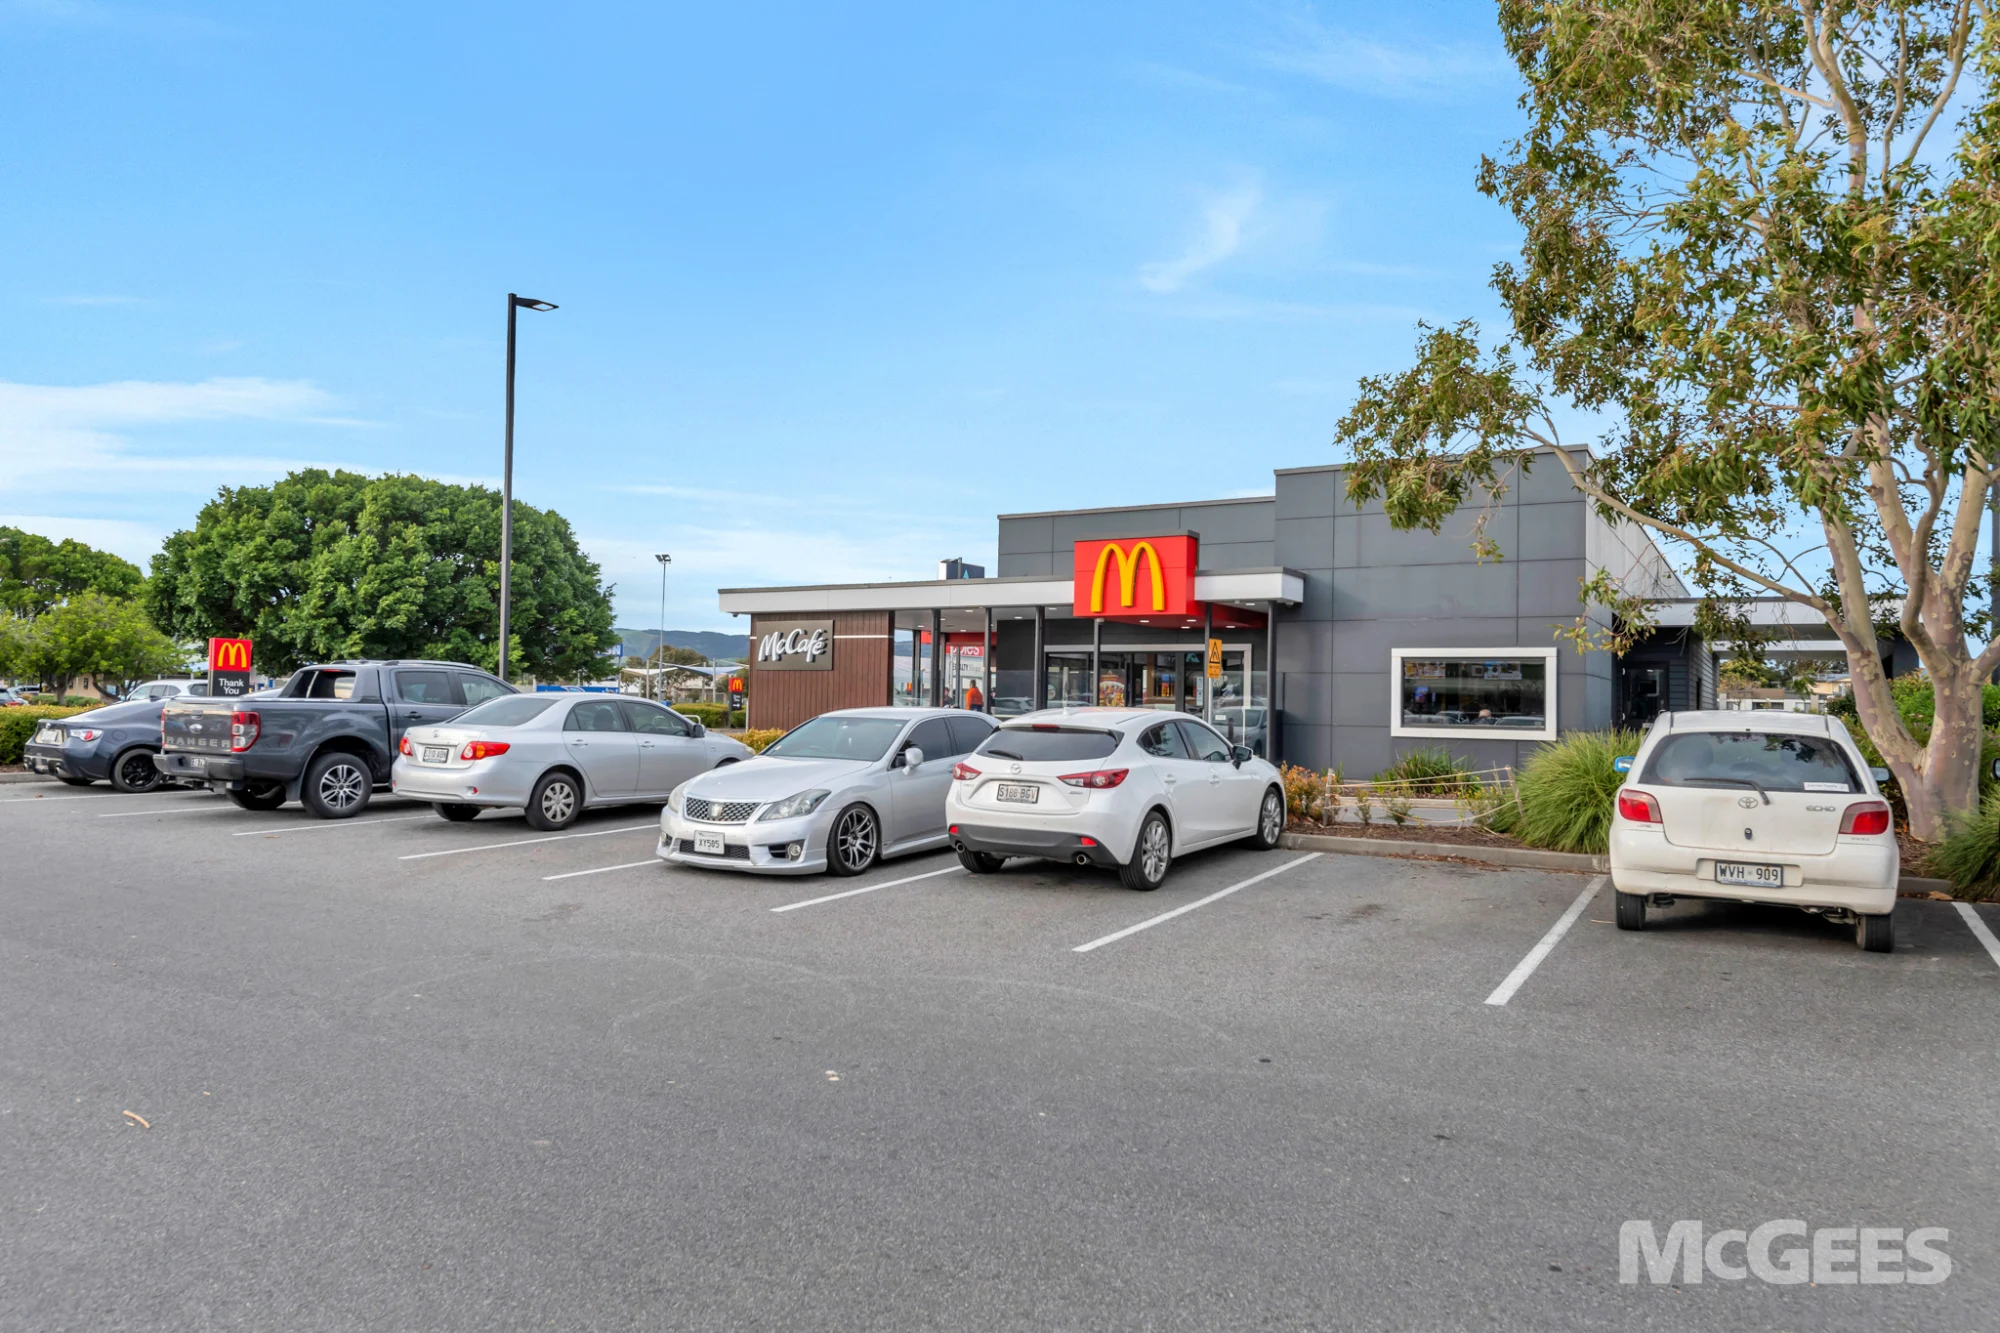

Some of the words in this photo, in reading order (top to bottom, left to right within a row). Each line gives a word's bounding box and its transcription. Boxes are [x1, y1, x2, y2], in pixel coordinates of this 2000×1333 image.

[758, 628, 825, 663] McCafé
[219, 678, 244, 687] Thank
[223, 686, 240, 695] You
[166, 736, 231, 748] RANGER
[1719, 865, 1745, 879] WVH
[1756, 867, 1779, 881] 909
